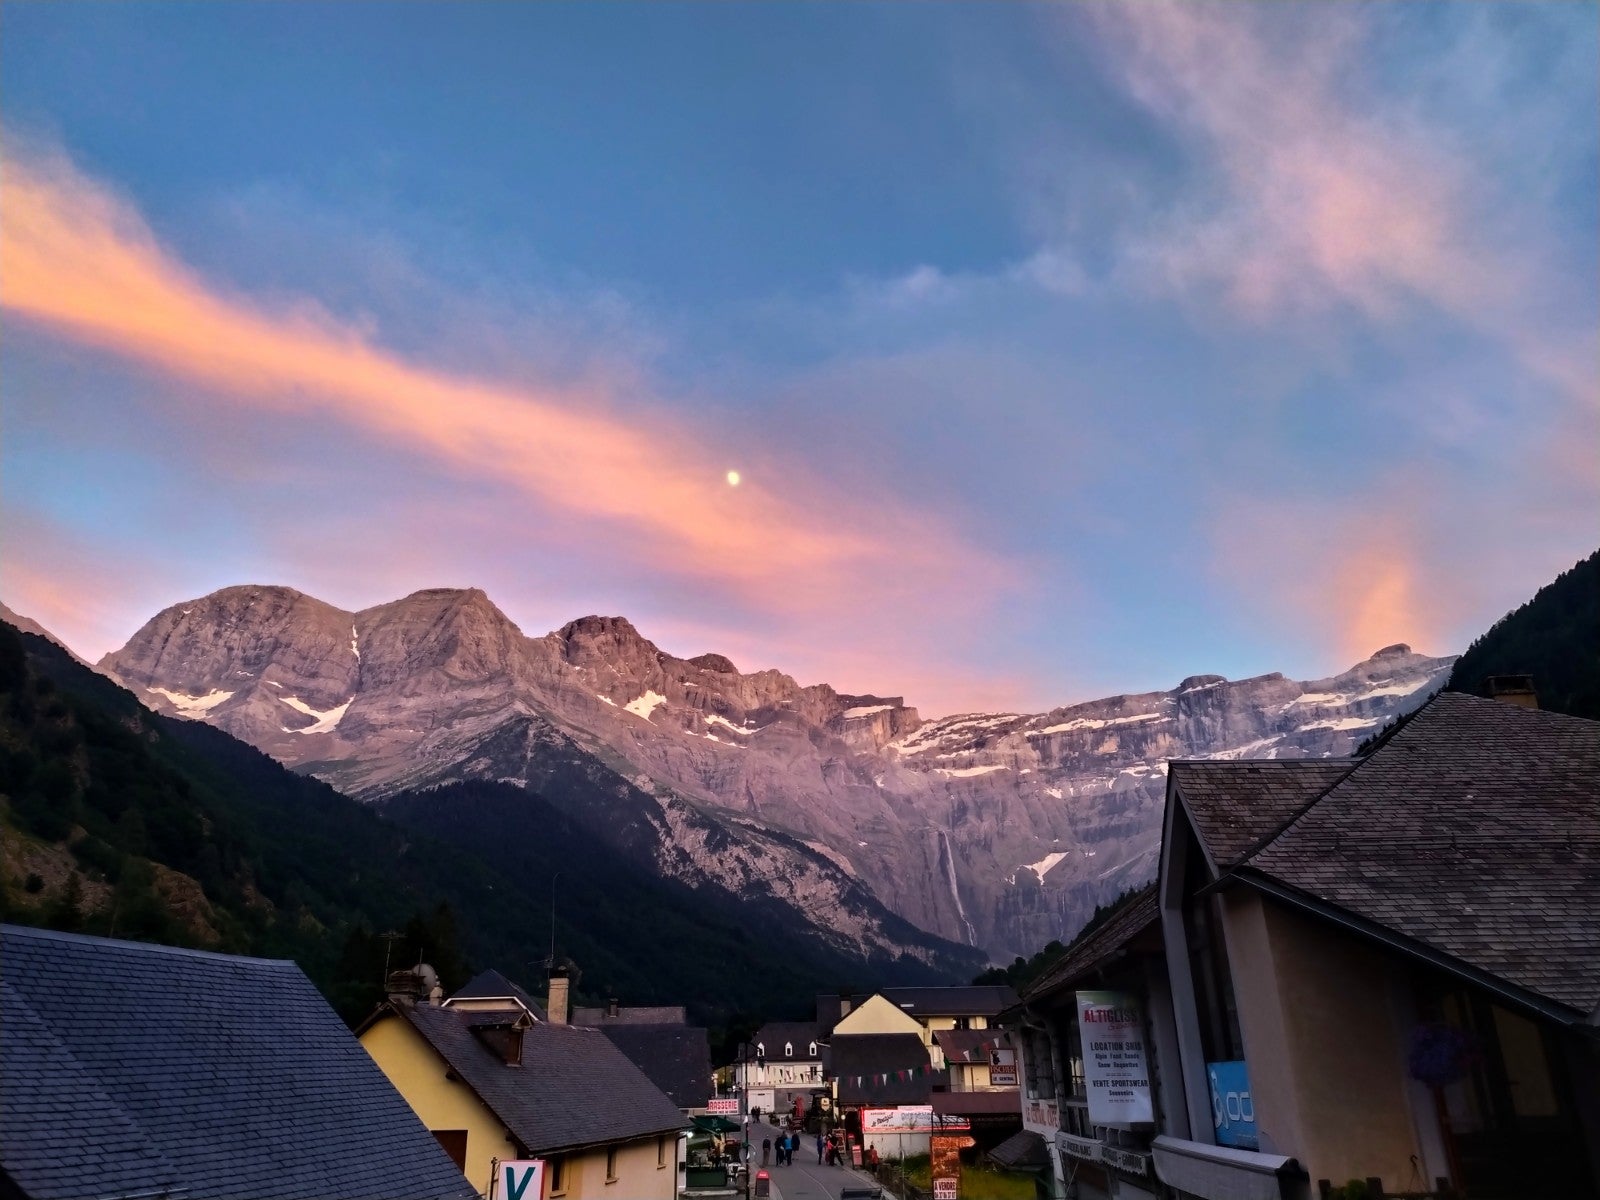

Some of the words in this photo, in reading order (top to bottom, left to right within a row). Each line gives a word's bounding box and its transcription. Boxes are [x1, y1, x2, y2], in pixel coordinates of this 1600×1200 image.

[1084, 1009, 1138, 1023] ALTIGLISS
[1090, 1042, 1124, 1051] LOCATION
[1092, 1080, 1109, 1088] VENTE
[506, 1167, 536, 1200] V
